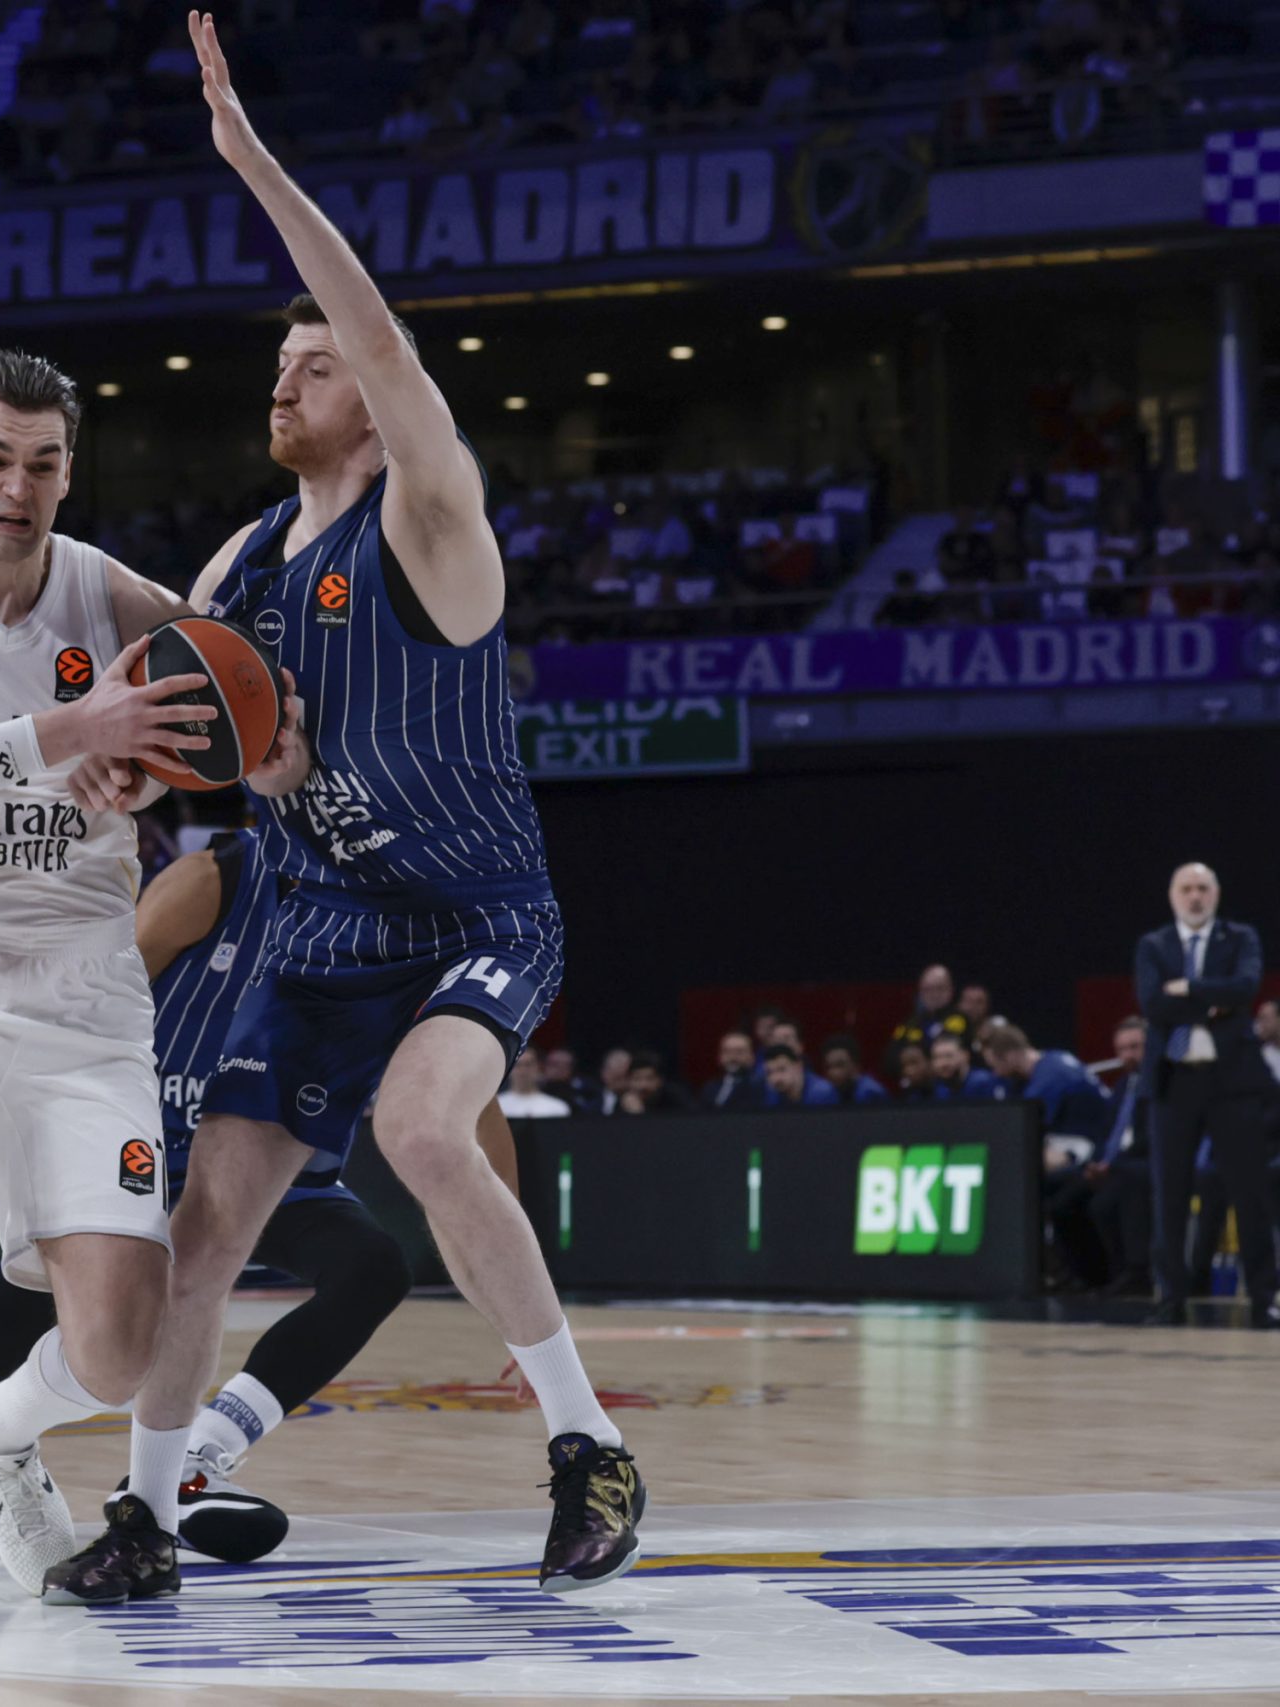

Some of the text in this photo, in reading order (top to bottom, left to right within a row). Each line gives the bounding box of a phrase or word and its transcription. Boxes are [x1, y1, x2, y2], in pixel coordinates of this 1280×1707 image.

[317, 147, 776, 277] MADRID
[626, 619, 1218, 693] REAL MADRID
[536, 727, 651, 769] EXIT
[858, 1165, 983, 1234] BKT
